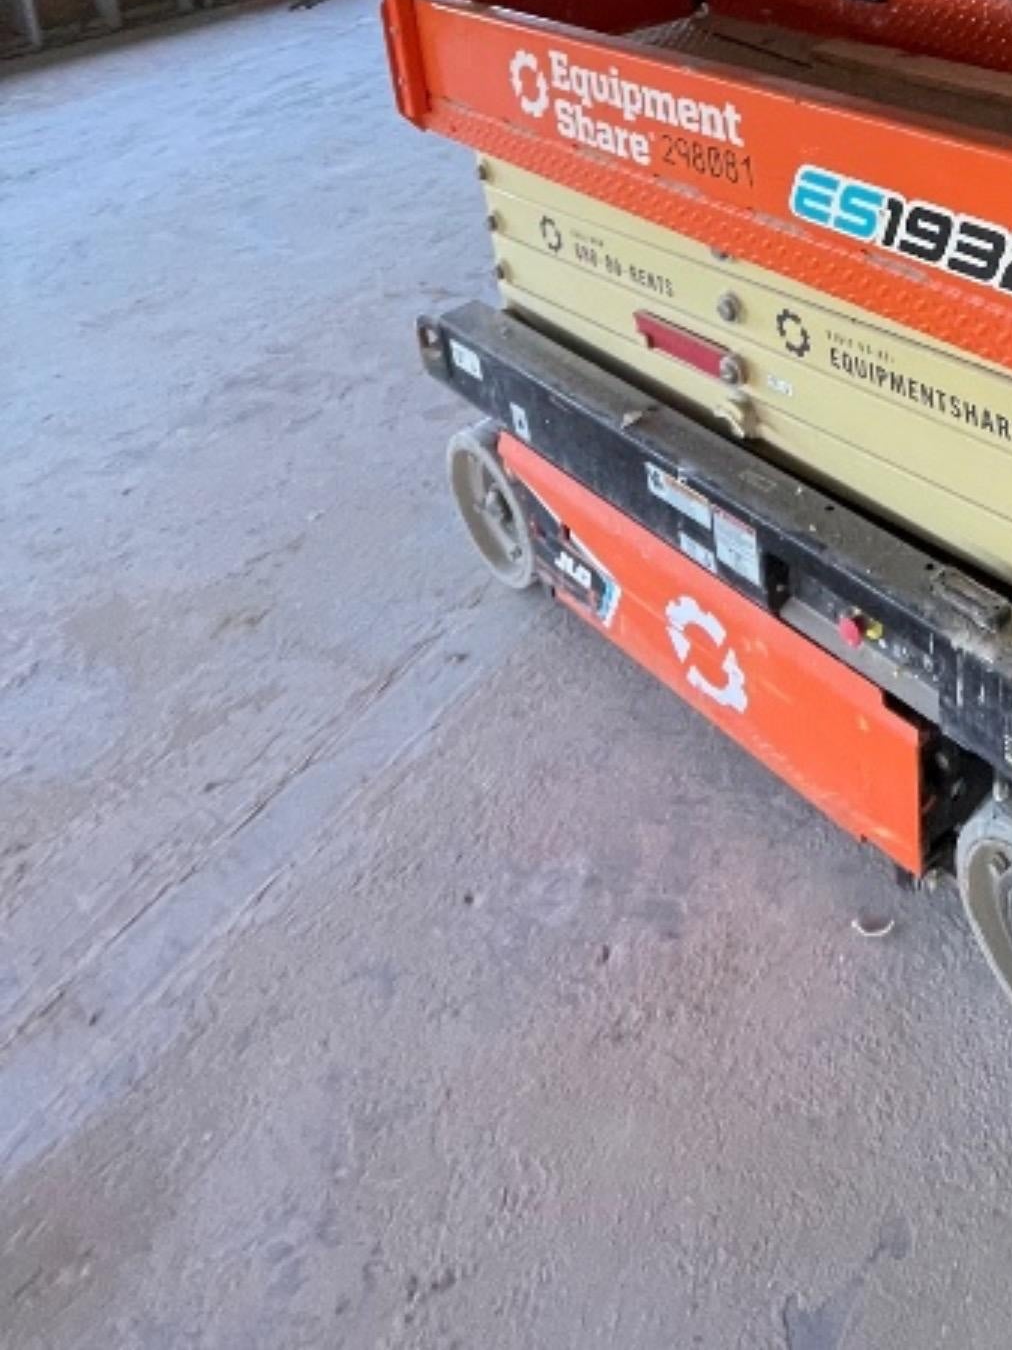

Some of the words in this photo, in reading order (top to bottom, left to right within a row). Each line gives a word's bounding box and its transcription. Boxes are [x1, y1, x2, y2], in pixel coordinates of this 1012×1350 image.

[548, 49, 745, 148] Equipment
[554, 98, 652, 166] Share
[661, 133, 755, 187] 298081
